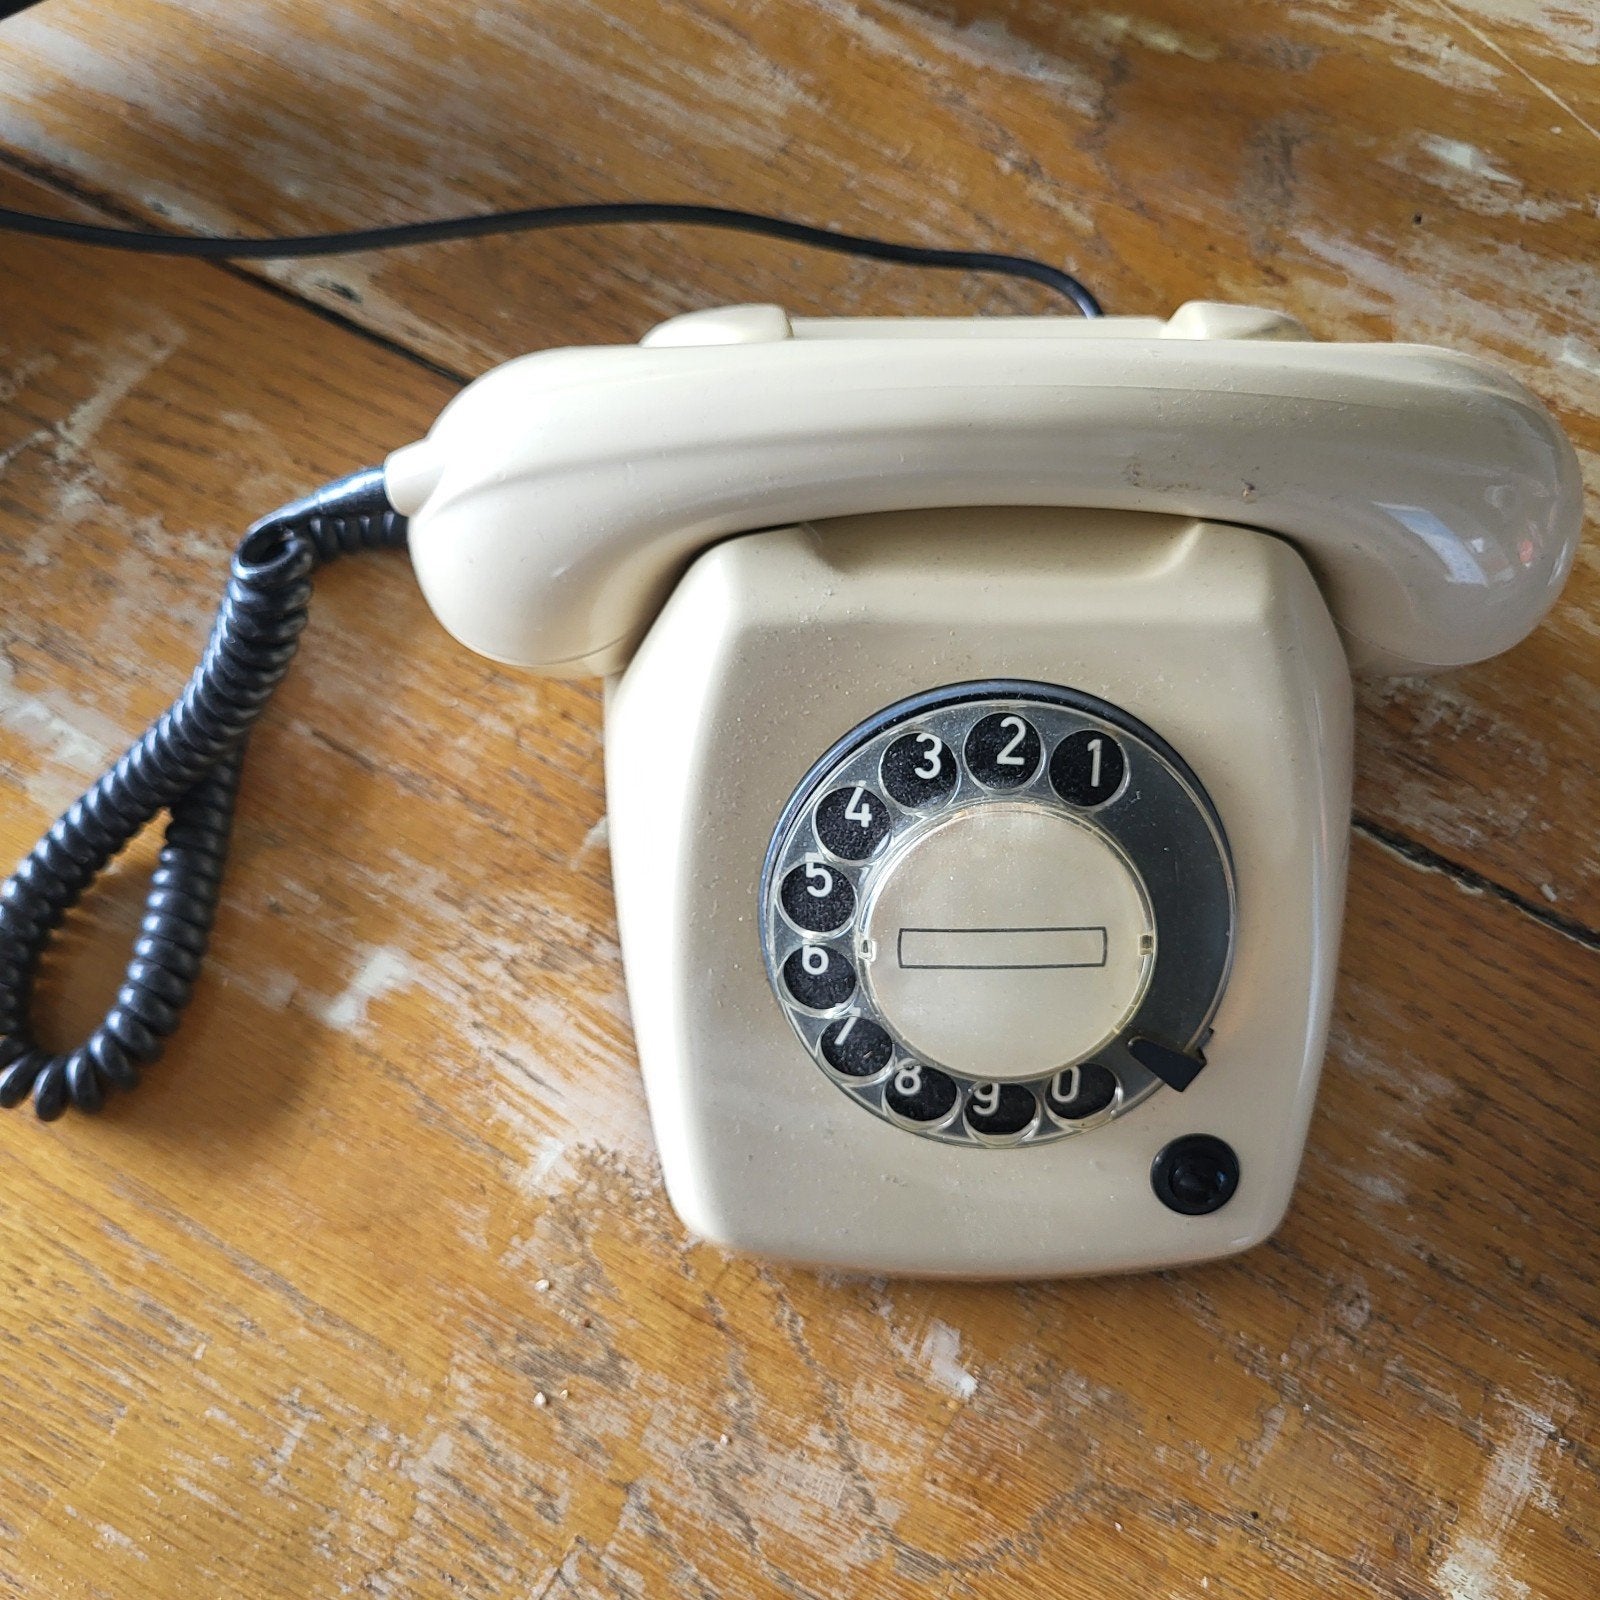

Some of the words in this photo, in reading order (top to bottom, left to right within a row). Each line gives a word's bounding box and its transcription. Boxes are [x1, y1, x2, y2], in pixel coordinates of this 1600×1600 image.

[914, 733, 943, 780] 3
[996, 716, 1027, 766] 2
[1086, 738, 1103, 788] 1
[844, 780, 873, 828] 4
[804, 852, 834, 898] 5
[802, 939, 830, 976] 6
[894, 1057, 922, 1096] 8
[972, 1080, 1000, 1116] 9
[1051, 1065, 1081, 1104] 0
